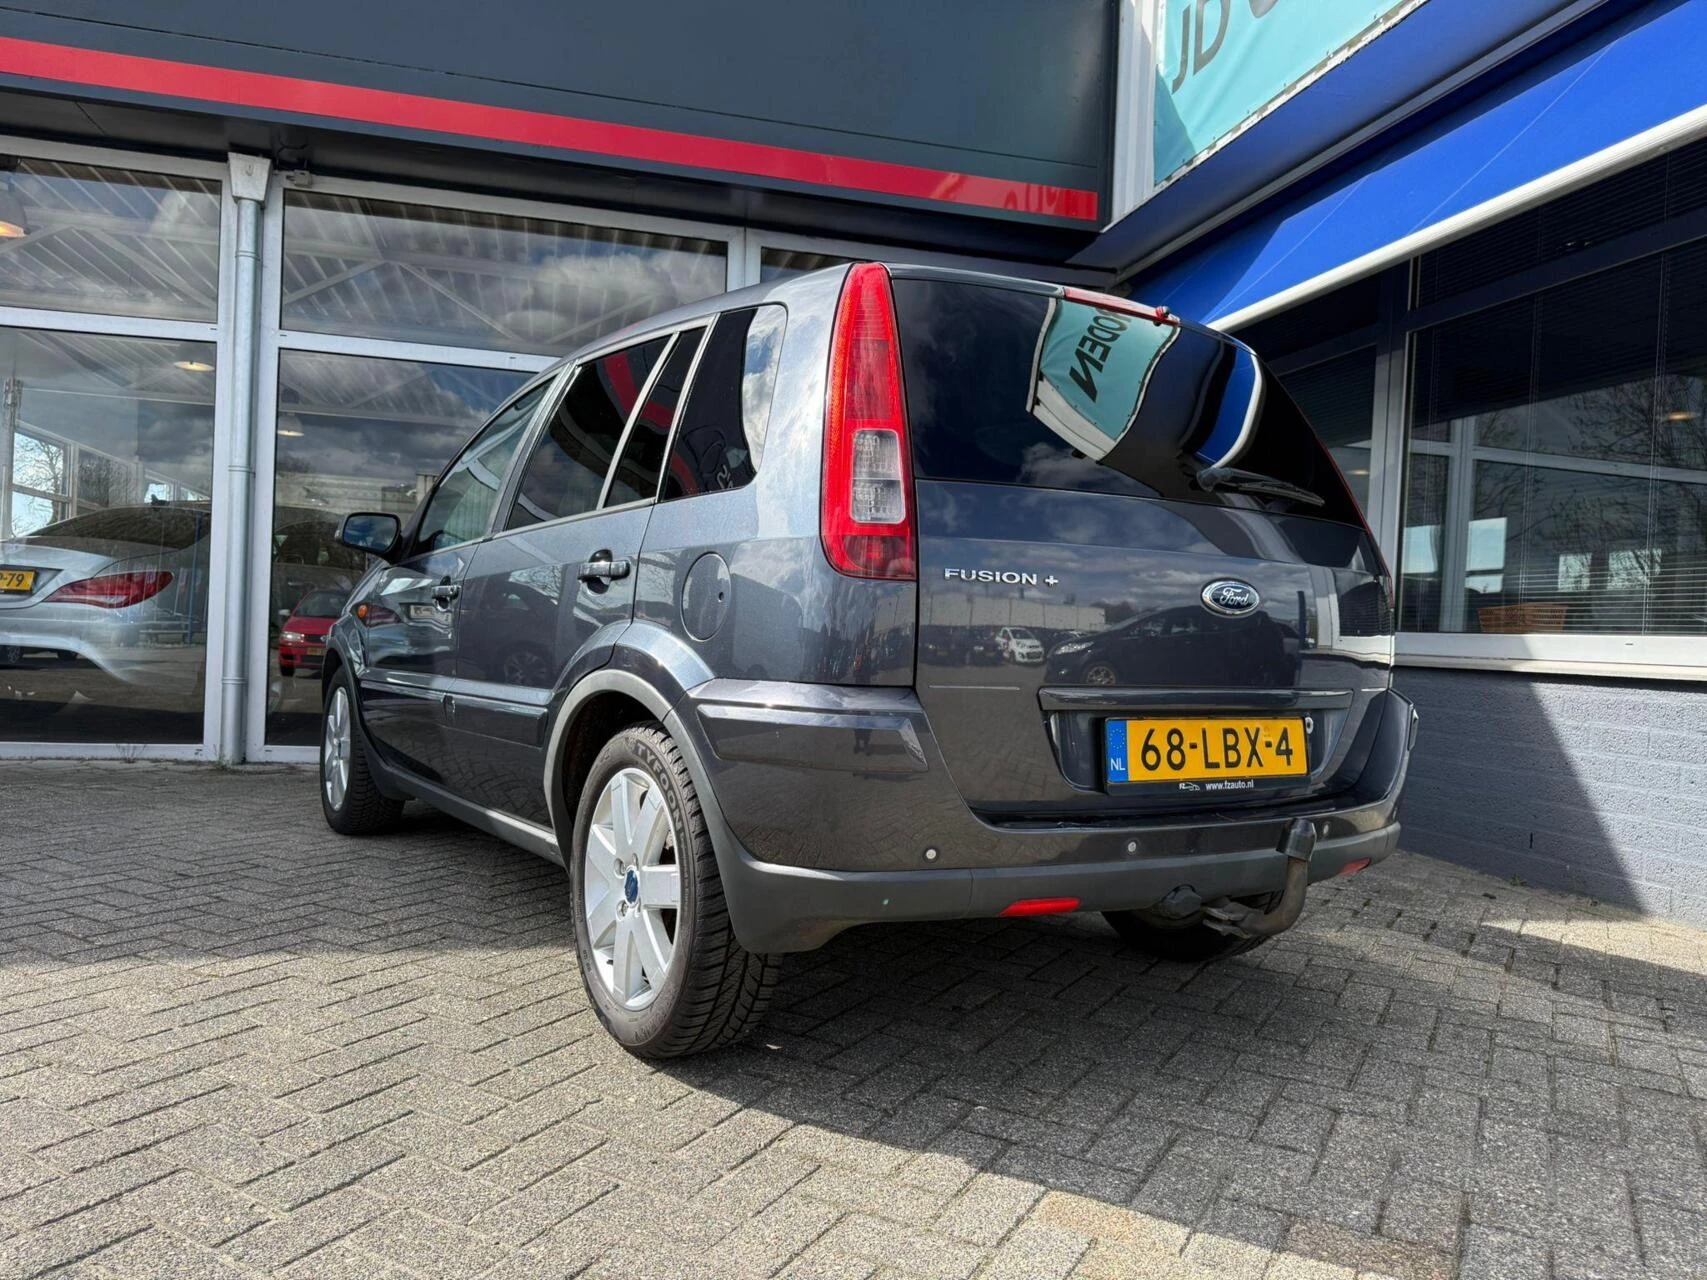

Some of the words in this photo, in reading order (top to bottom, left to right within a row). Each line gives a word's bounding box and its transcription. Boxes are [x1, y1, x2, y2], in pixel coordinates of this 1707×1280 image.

[944, 568, 1038, 586] FUSION
[1219, 588, 1250, 606] Ford
[1141, 726, 1294, 772] 68-LBX-4
[1110, 757, 1126, 772] NL
[636, 742, 684, 832] TYFOON
[1205, 779, 1254, 791] www.fzauto.nl
